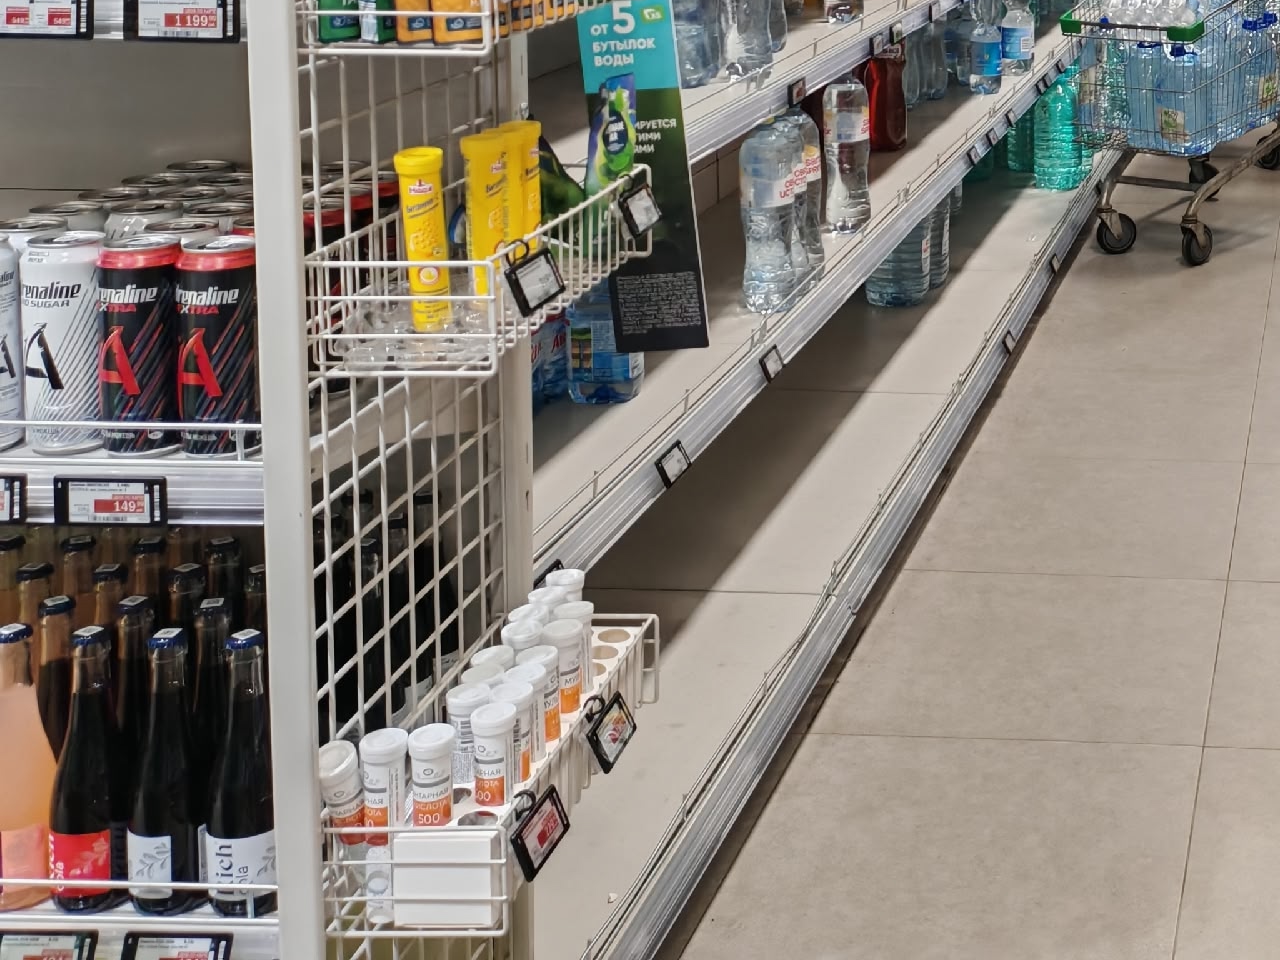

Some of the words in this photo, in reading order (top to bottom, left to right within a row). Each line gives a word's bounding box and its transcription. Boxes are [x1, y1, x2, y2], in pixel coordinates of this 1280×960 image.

[590, 23, 608, 37] ОТ
[613, 0, 636, 35] 5
[592, 37, 656, 53] БУТЫЛОК
[594, 53, 634, 67] ВОДЫ
[33, 299, 71, 309] SUGAR
[113, 500, 136, 512] 149
[413, 788, 449, 801] НТАРНАЯ
[419, 813, 440, 825] 500
